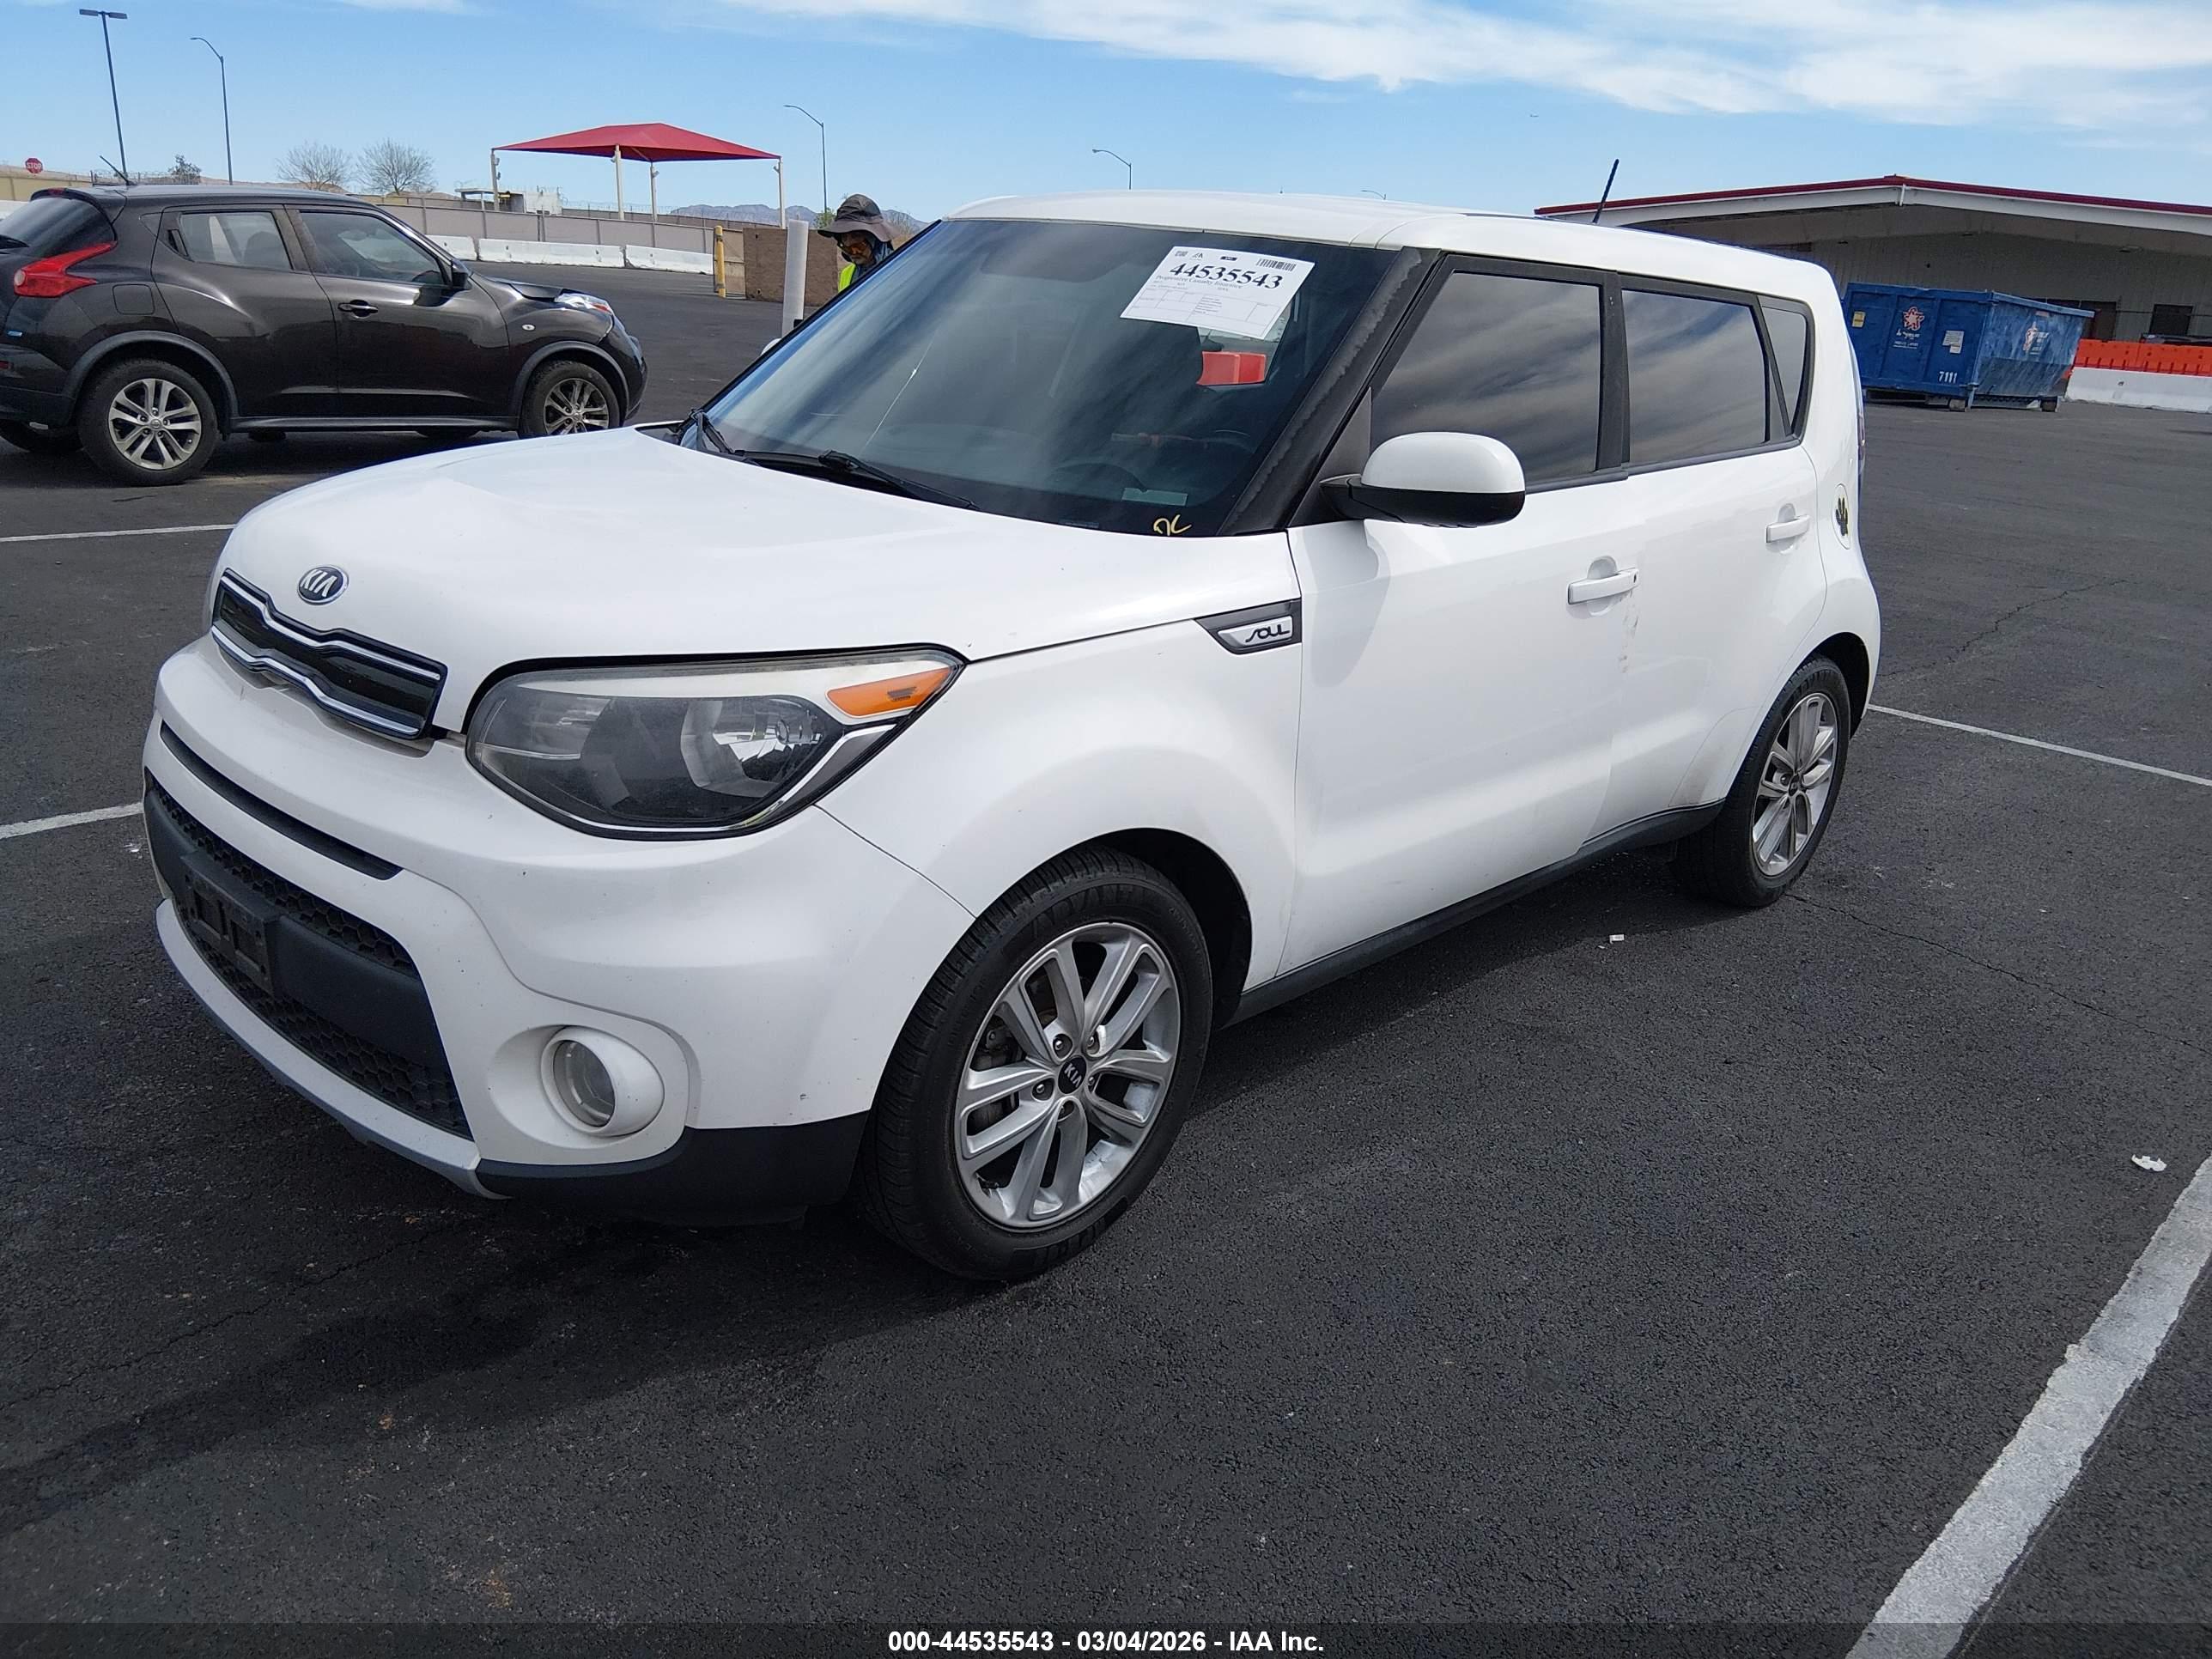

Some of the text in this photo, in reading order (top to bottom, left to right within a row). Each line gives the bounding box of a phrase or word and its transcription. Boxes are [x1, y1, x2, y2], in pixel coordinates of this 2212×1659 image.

[1170, 263, 1283, 289] 44535543
[1939, 371, 1957, 383] 7111
[300, 568, 337, 597] KIA
[1064, 1063, 1082, 1088] KIA
